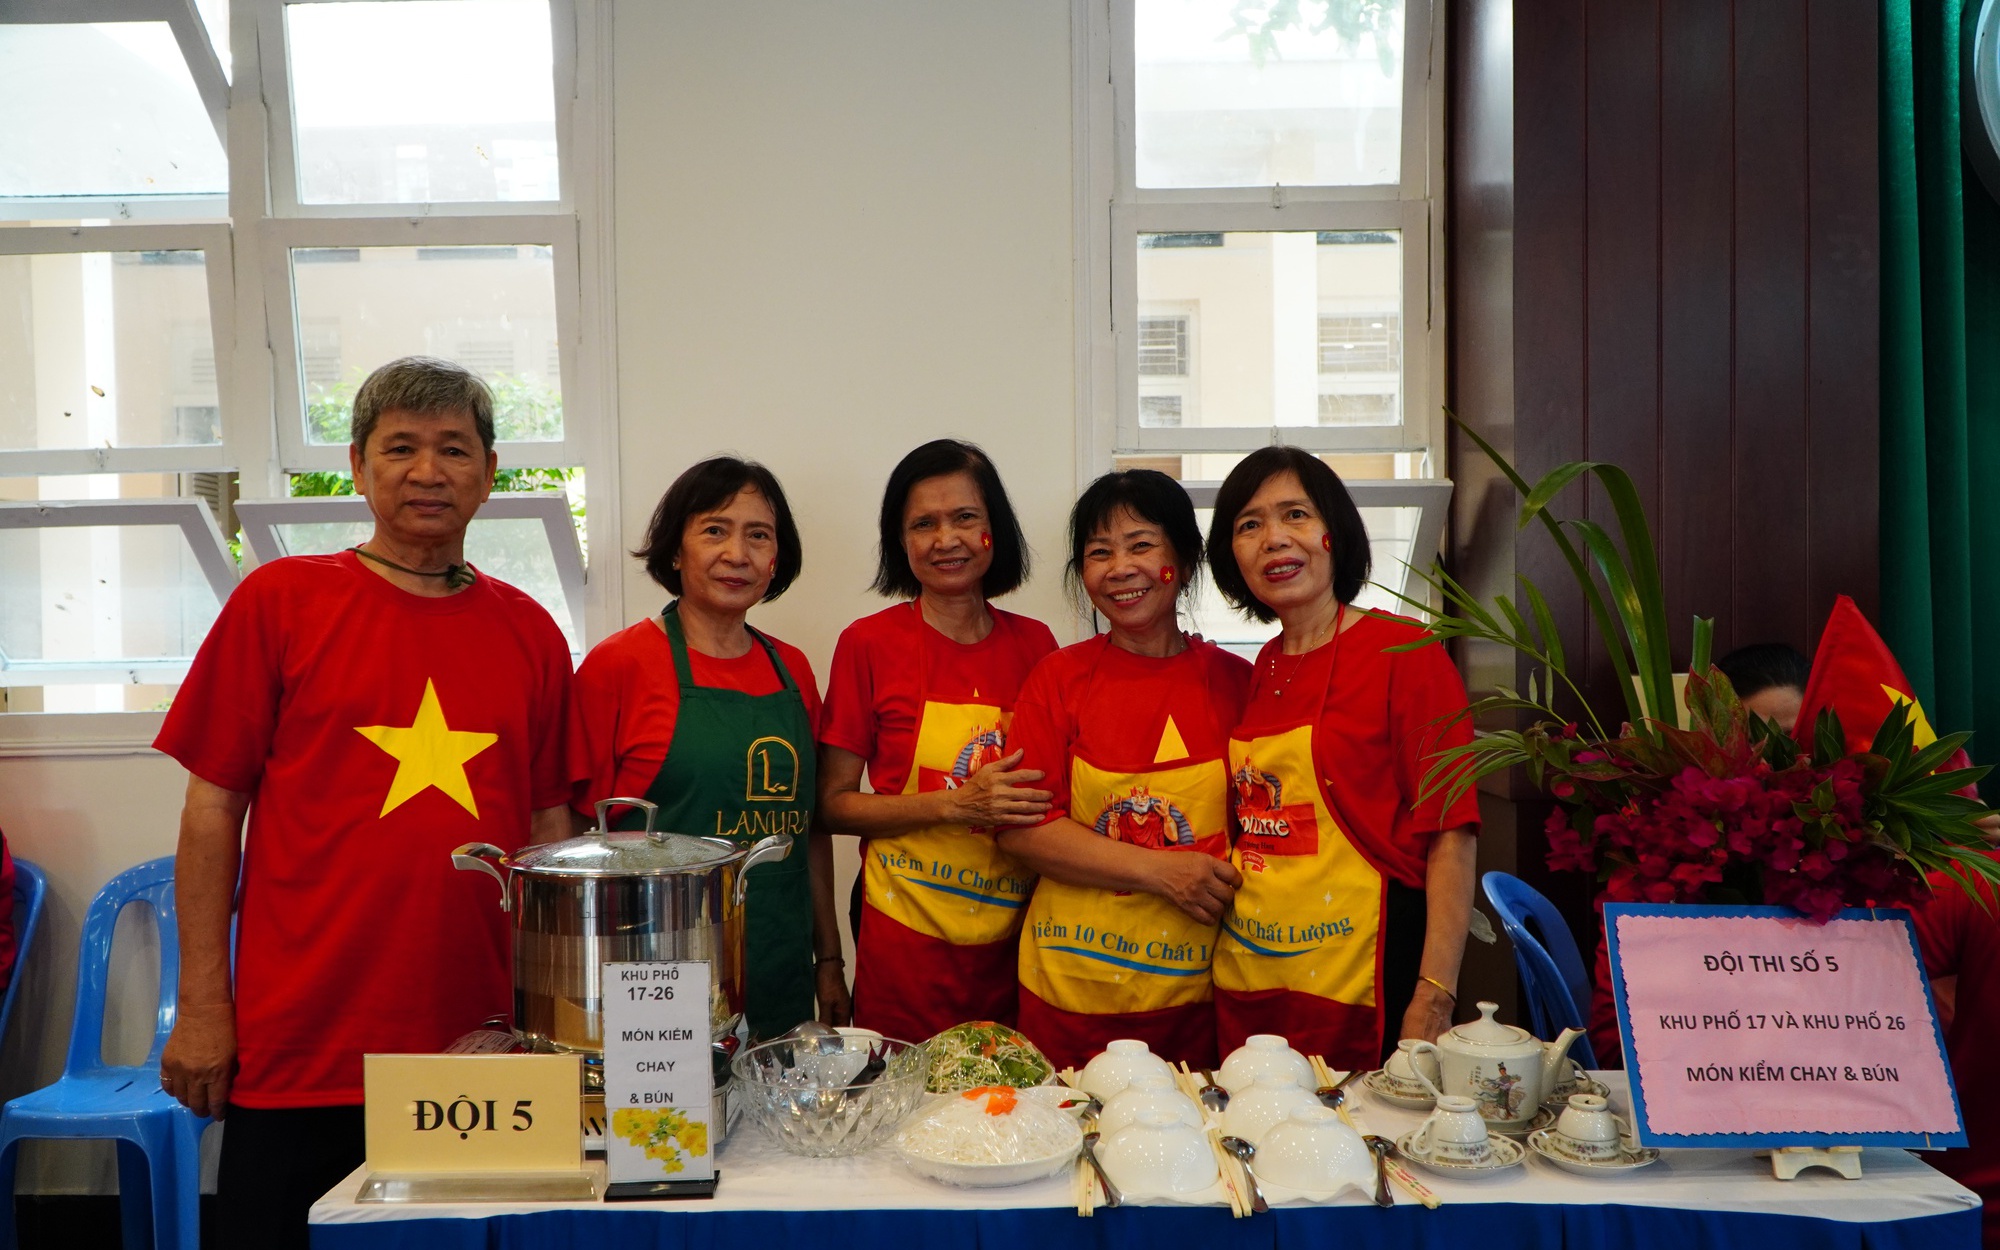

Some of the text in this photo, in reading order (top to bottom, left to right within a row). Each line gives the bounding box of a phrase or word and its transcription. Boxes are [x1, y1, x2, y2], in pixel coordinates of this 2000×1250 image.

[931, 860, 953, 880] 10
[958, 868, 993, 891] Cho
[1031, 916, 1068, 943] iểm
[1074, 924, 1095, 944] 10
[1100, 932, 1140, 955] Cho
[1145, 940, 1194, 962] Chất
[1246, 918, 1284, 943] Chất
[1288, 916, 1355, 944] Lượng
[1703, 949, 1839, 976] ĐỘI THI SỐ 5
[621, 970, 648, 982] KHU
[627, 986, 674, 1001] 17-26
[1659, 1009, 1906, 1031] KHU PHỐ 17 VÀ KHU PHỐ 26
[621, 1028, 654, 1042] MÓN
[636, 1061, 676, 1073] CHAY
[1686, 1060, 1900, 1082] MÓN KIỂM CHAY & BÚN
[629, 1090, 674, 1104] & BÚN
[412, 1094, 533, 1140] ĐỘI 5
